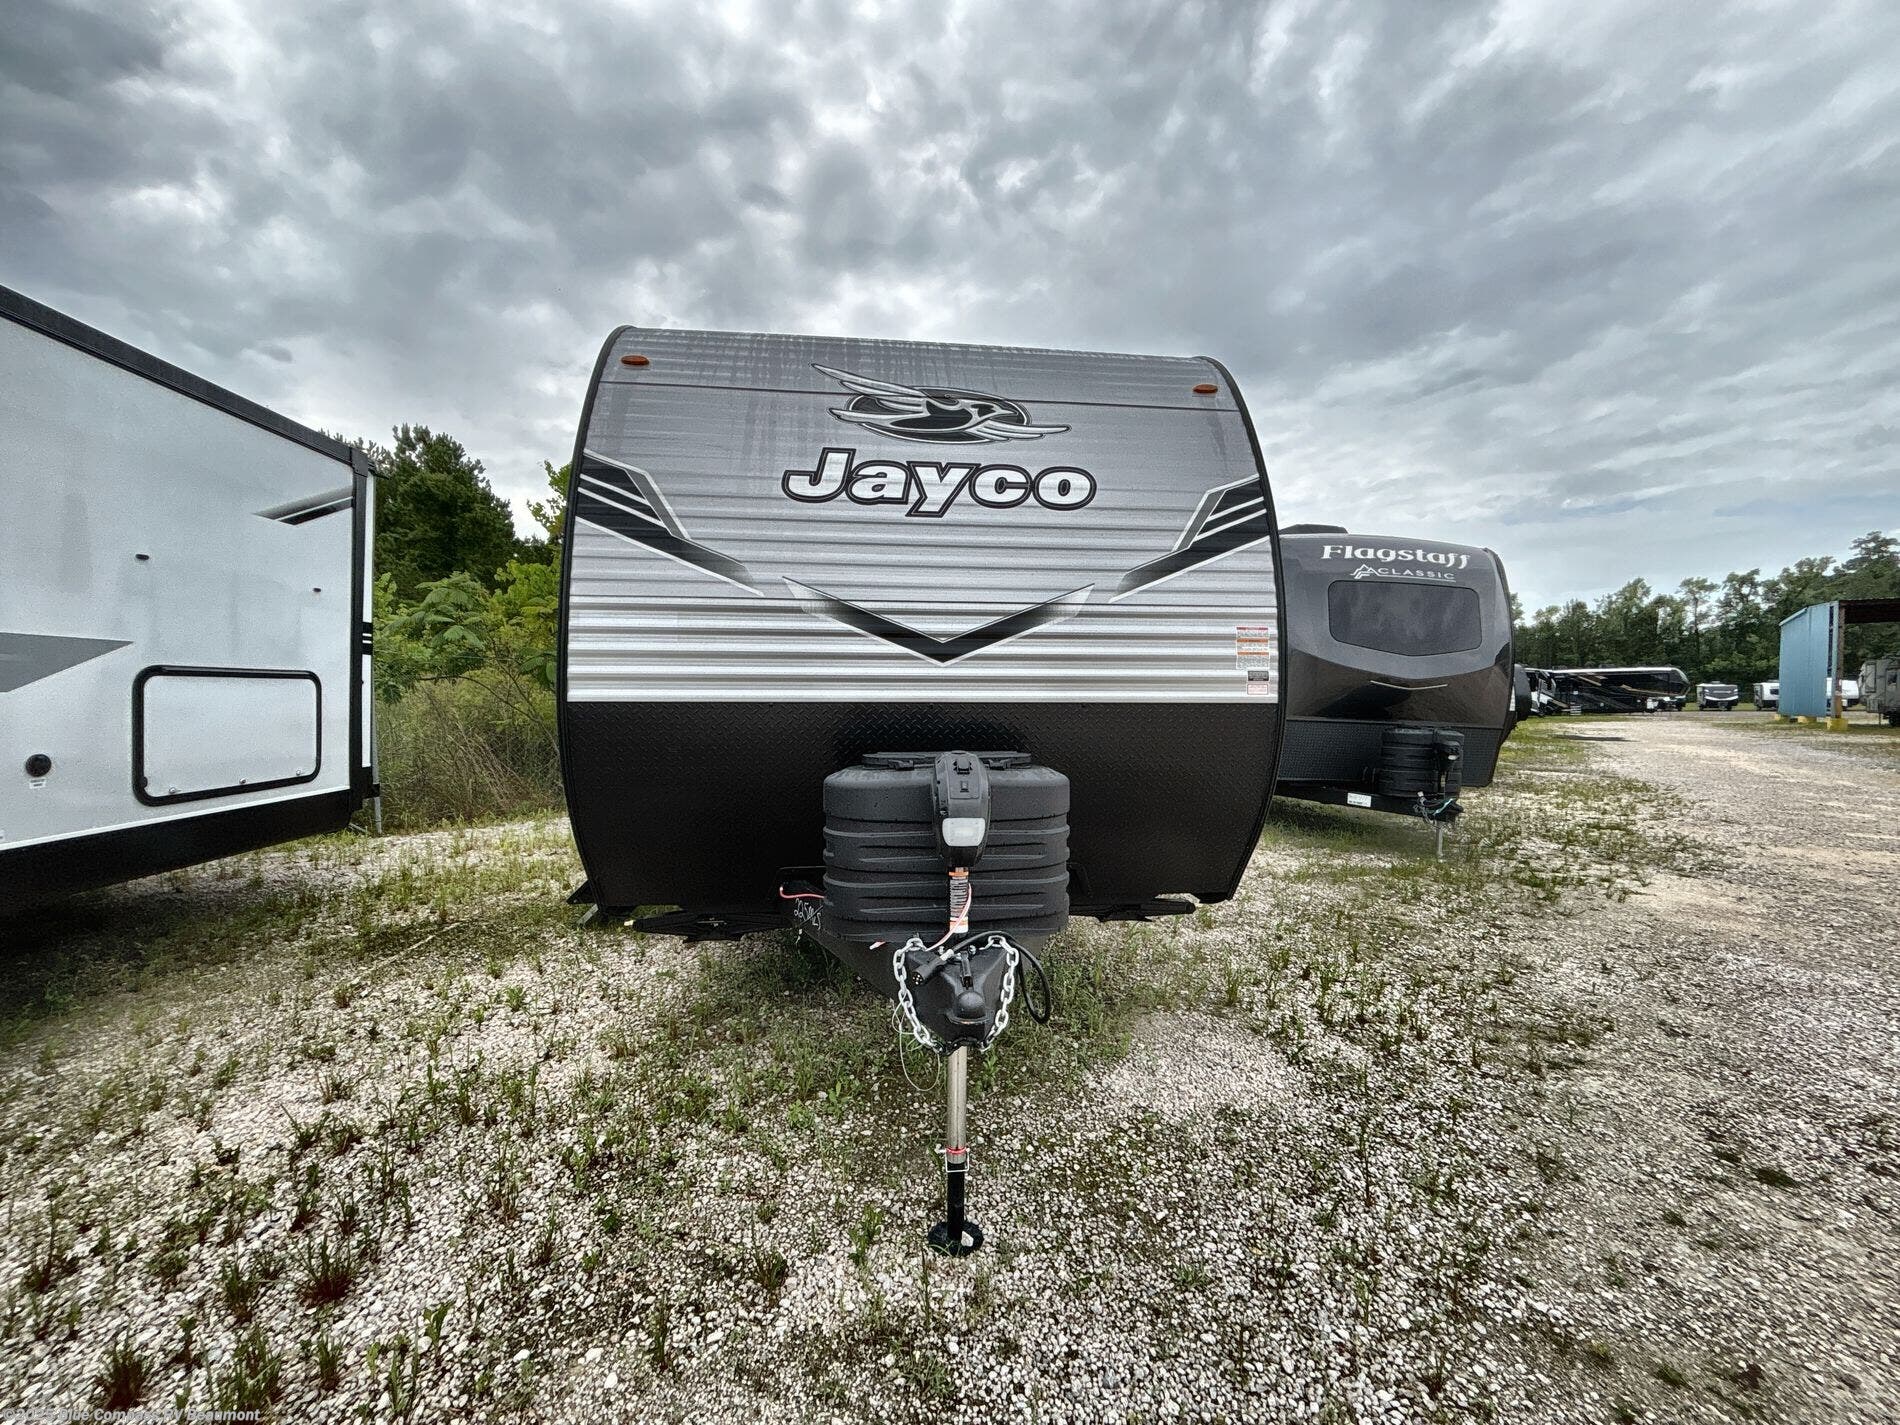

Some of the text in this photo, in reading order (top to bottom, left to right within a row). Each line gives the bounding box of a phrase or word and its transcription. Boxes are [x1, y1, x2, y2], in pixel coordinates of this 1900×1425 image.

[781, 447, 1097, 518] Jayco
[1320, 545, 1471, 569] Flagstaff
[1377, 567, 1457, 580] CLASSIC
